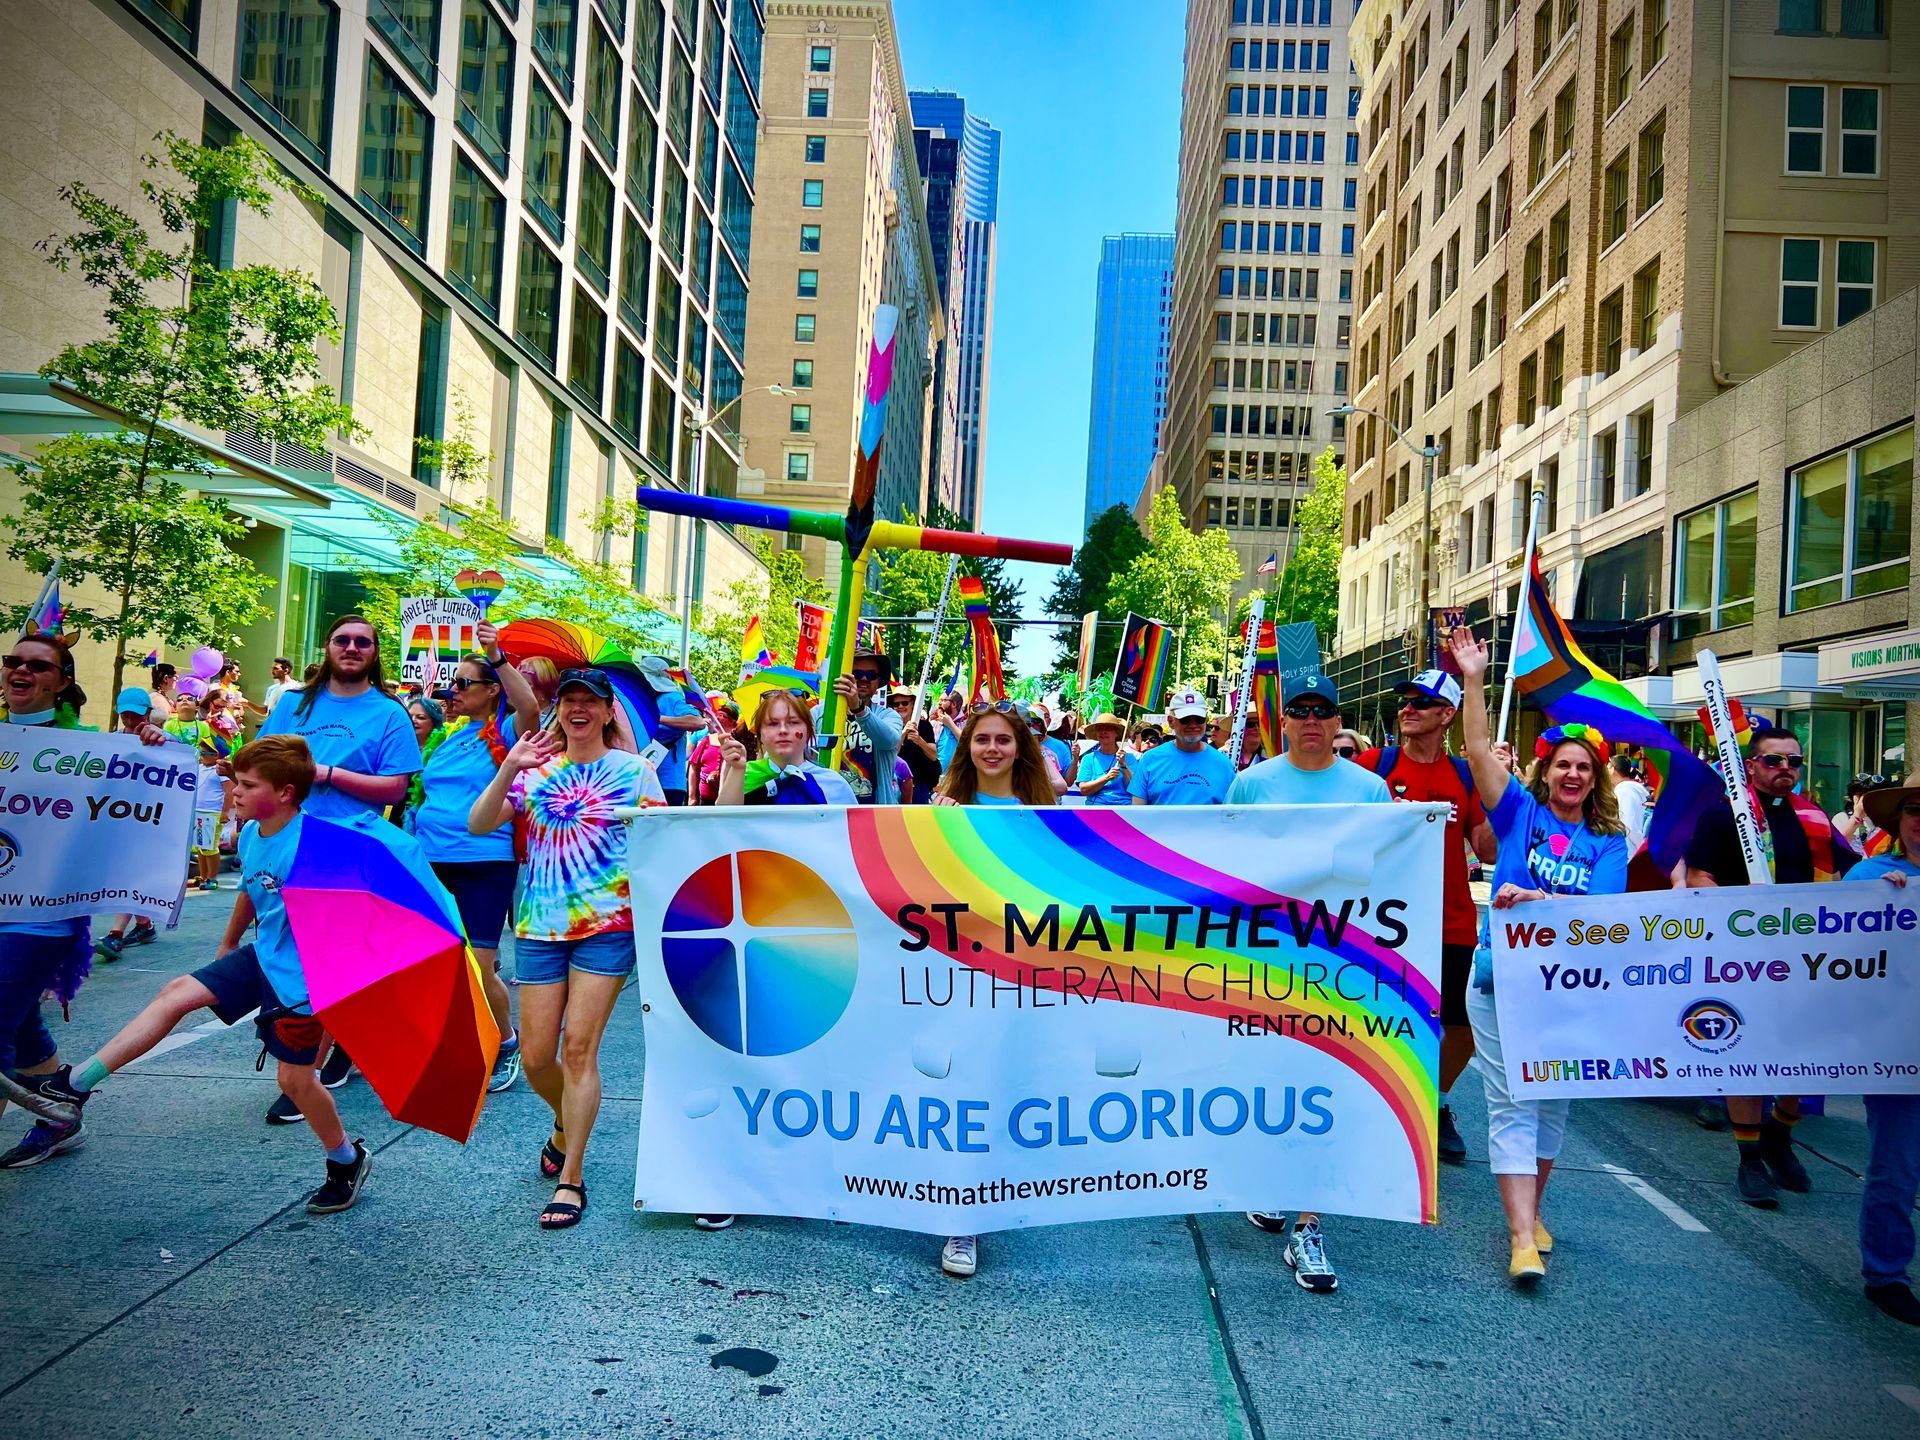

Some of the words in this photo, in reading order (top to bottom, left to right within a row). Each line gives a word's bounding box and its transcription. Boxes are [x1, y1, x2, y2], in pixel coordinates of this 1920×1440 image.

[400, 602, 422, 628] MAPLE
[421, 598, 438, 613] LEAF
[443, 599, 482, 622] LUTHERAN
[426, 614, 456, 624] Church
[402, 664, 422, 679] are
[1281, 668, 1298, 679] HOLY
[1299, 663, 1320, 676] SPIRIT
[1851, 648, 1883, 669] VISIONS
[33, 748, 198, 792] Celebrate
[1703, 680, 1722, 731] CENTRAL
[1718, 740, 1739, 801] LUTHERAN
[1735, 812, 1754, 864] CHURCH
[86, 795, 164, 825] You!
[1527, 848, 1592, 892] PRDE
[29, 887, 128, 908] Washington
[132, 890, 178, 910] Synod
[897, 902, 983, 953] ST.
[1505, 922, 1557, 949] We
[1567, 919, 1630, 946] See
[1640, 915, 1715, 942] You,
[1727, 903, 1919, 938] Celebrate
[1539, 963, 1611, 991] You,
[1622, 957, 1692, 986] and
[1704, 956, 1791, 984] Love
[1801, 949, 1888, 981] You!
[900, 965, 1162, 1010] LUTHERAN
[1183, 961, 1407, 1003] CHURCH
[1227, 1014, 1355, 1041] RENTON,
[1363, 1016, 1417, 1040] WA
[1683, 1035, 1719, 1055] Reconciling
[1727, 1034, 1743, 1050] Christ
[1522, 1056, 1669, 1083] LUTHERANS
[1676, 1061, 1694, 1079] of
[1695, 1062, 1724, 1078] the
[1729, 1062, 1758, 1077] NW
[1763, 1062, 1870, 1081] Washington
[732, 1085, 861, 1141] YOU
[873, 1094, 990, 1154] ARE
[1007, 1085, 1335, 1152] GLORIOUS
[844, 1165, 1209, 1206] www.stmatthewsrenton.org
